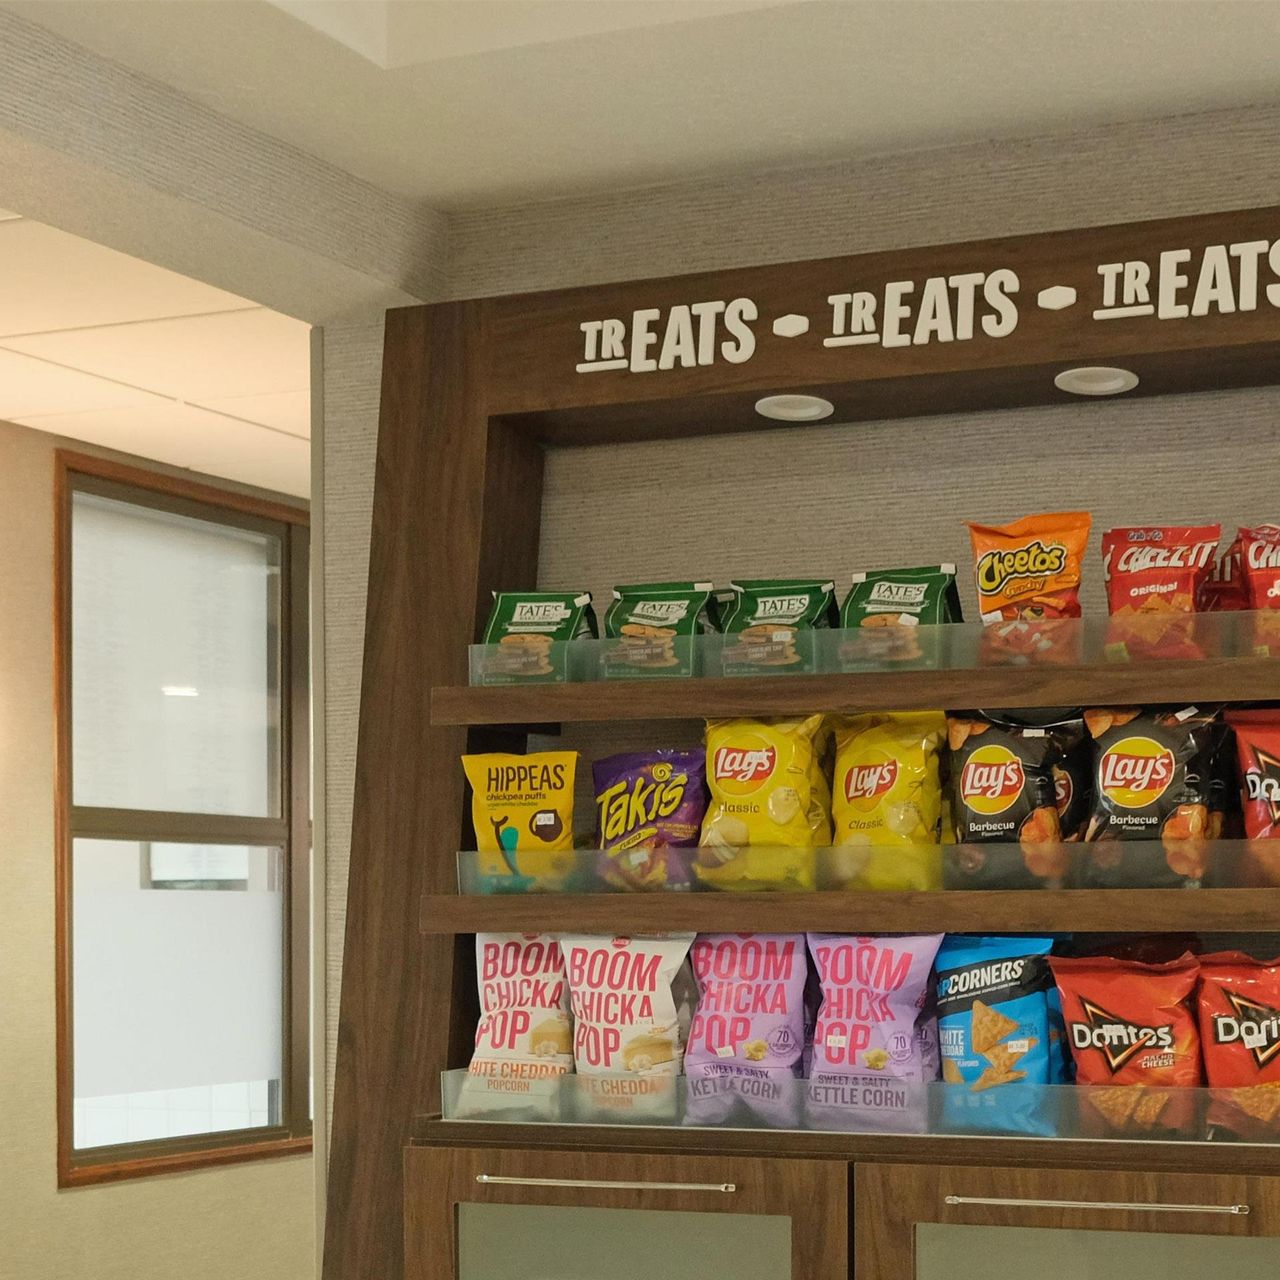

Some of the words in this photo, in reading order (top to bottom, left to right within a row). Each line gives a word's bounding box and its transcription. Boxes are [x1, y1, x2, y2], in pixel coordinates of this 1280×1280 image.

[576, 297, 758, 372] TREATS
[824, 269, 1020, 347] TREATS
[977, 541, 1064, 593] Cheetos
[760, 597, 807, 612] TATE'S
[876, 583, 925, 597] TATE'S
[487, 764, 565, 792] HIPPEAS
[848, 763, 896, 799] Lay's
[964, 761, 1020, 799] Lay's
[1104, 754, 1170, 792] Lay's
[486, 792, 523, 801] chickpea
[524, 791, 546, 801] puffs
[596, 763, 688, 849] Takis
[848, 818, 884, 830] Classic
[969, 821, 1015, 832] Barbecue
[1109, 815, 1159, 826] Barbecue
[483, 942, 567, 981] BOOM
[570, 948, 663, 992] BOOM
[693, 940, 795, 981] BOOM
[816, 945, 913, 992] BOOM
[937, 961, 1024, 997] PCORNERS
[484, 979, 564, 1012] CHICKA
[571, 990, 655, 1026] CHICKA
[819, 988, 896, 1022] HICKA
[475, 1010, 531, 1050] POP
[576, 1022, 620, 1067] POP
[688, 1014, 751, 1057] POP
[777, 1030, 789, 1043] 70
[894, 1036, 906, 1049] 70
[471, 1061, 497, 1077] HITE
[704, 1064, 734, 1077] SWEET
[744, 1068, 769, 1079] SALTY
[1141, 1060, 1174, 1068] CHEESE
[487, 1079, 530, 1092] POPCORN
[601, 1079, 665, 1095] CHEDDA
[740, 1079, 781, 1099] CORN
[818, 1074, 849, 1086] SWEET
[851, 1076, 859, 1086] &
[862, 1077, 891, 1087] SALTY
[862, 1088, 906, 1108] CORN
